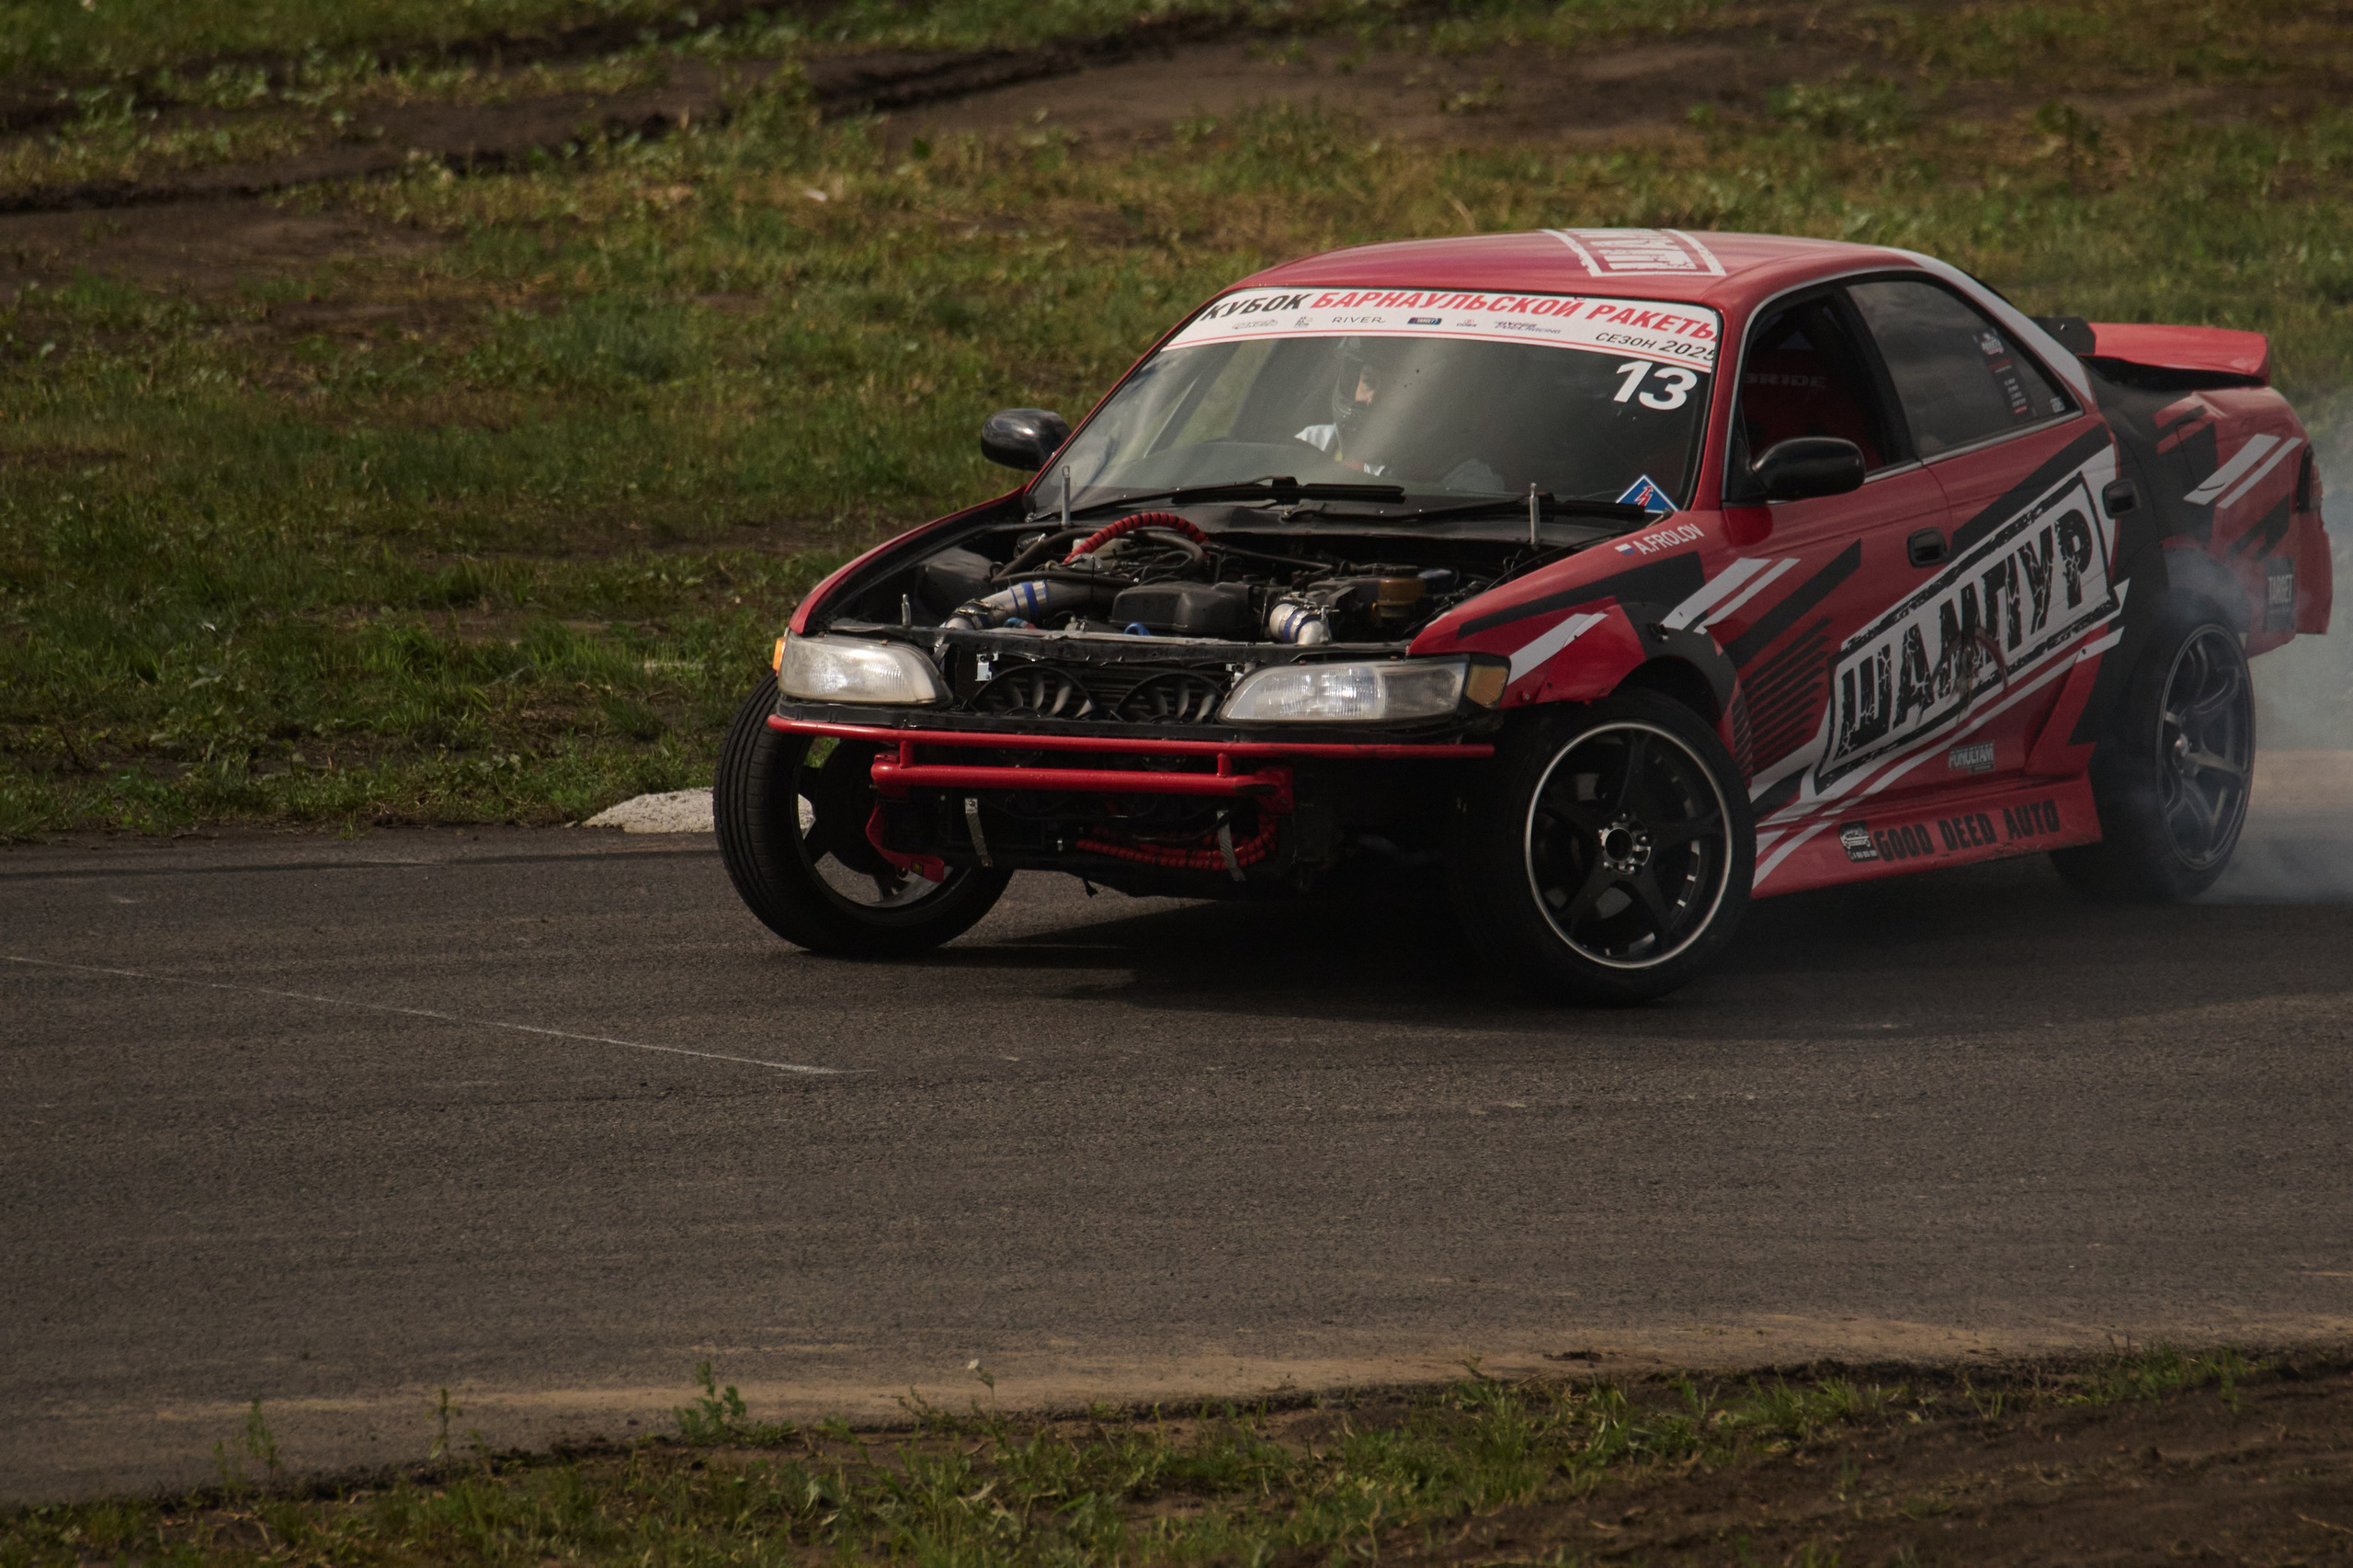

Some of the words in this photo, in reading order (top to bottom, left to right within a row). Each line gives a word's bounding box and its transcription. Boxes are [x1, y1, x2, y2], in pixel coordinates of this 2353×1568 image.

[1199, 293, 1313, 321] КУБОК
[1310, 291, 1587, 318] БАРНАУЛЬСКОЙ
[1585, 304, 1717, 342] РАКЕТЫ
[1595, 332, 1657, 349] СЕЗОН
[1658, 340, 1714, 361] 2025
[1613, 360, 1698, 411] 13
[1833, 508, 2093, 762] ШАМПУР
[1873, 824, 1935, 862] GOOD
[1937, 812, 1997, 851] DEED
[2003, 799, 2061, 840] AUTO
